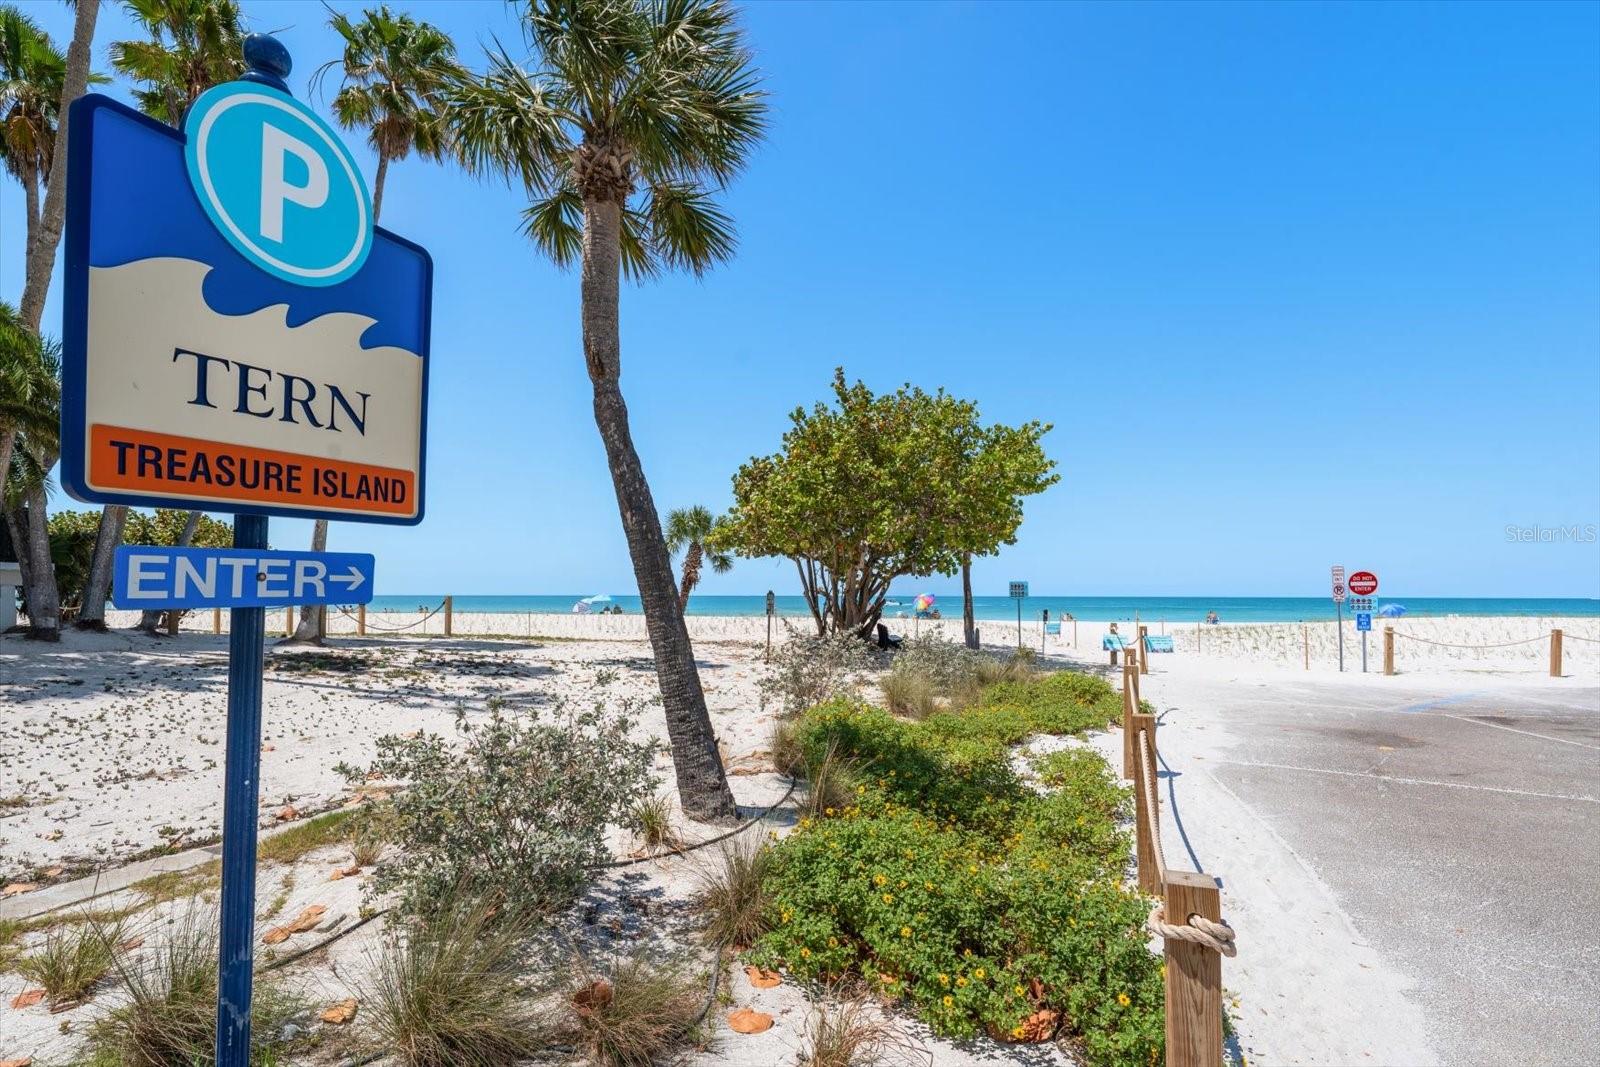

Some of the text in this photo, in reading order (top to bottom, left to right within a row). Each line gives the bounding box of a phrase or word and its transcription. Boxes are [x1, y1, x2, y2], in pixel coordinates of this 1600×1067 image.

[260, 122, 330, 243] P
[173, 348, 371, 436] TERN
[110, 440, 406, 504] TREASURE ISLAND
[127, 555, 326, 599] ENTER
